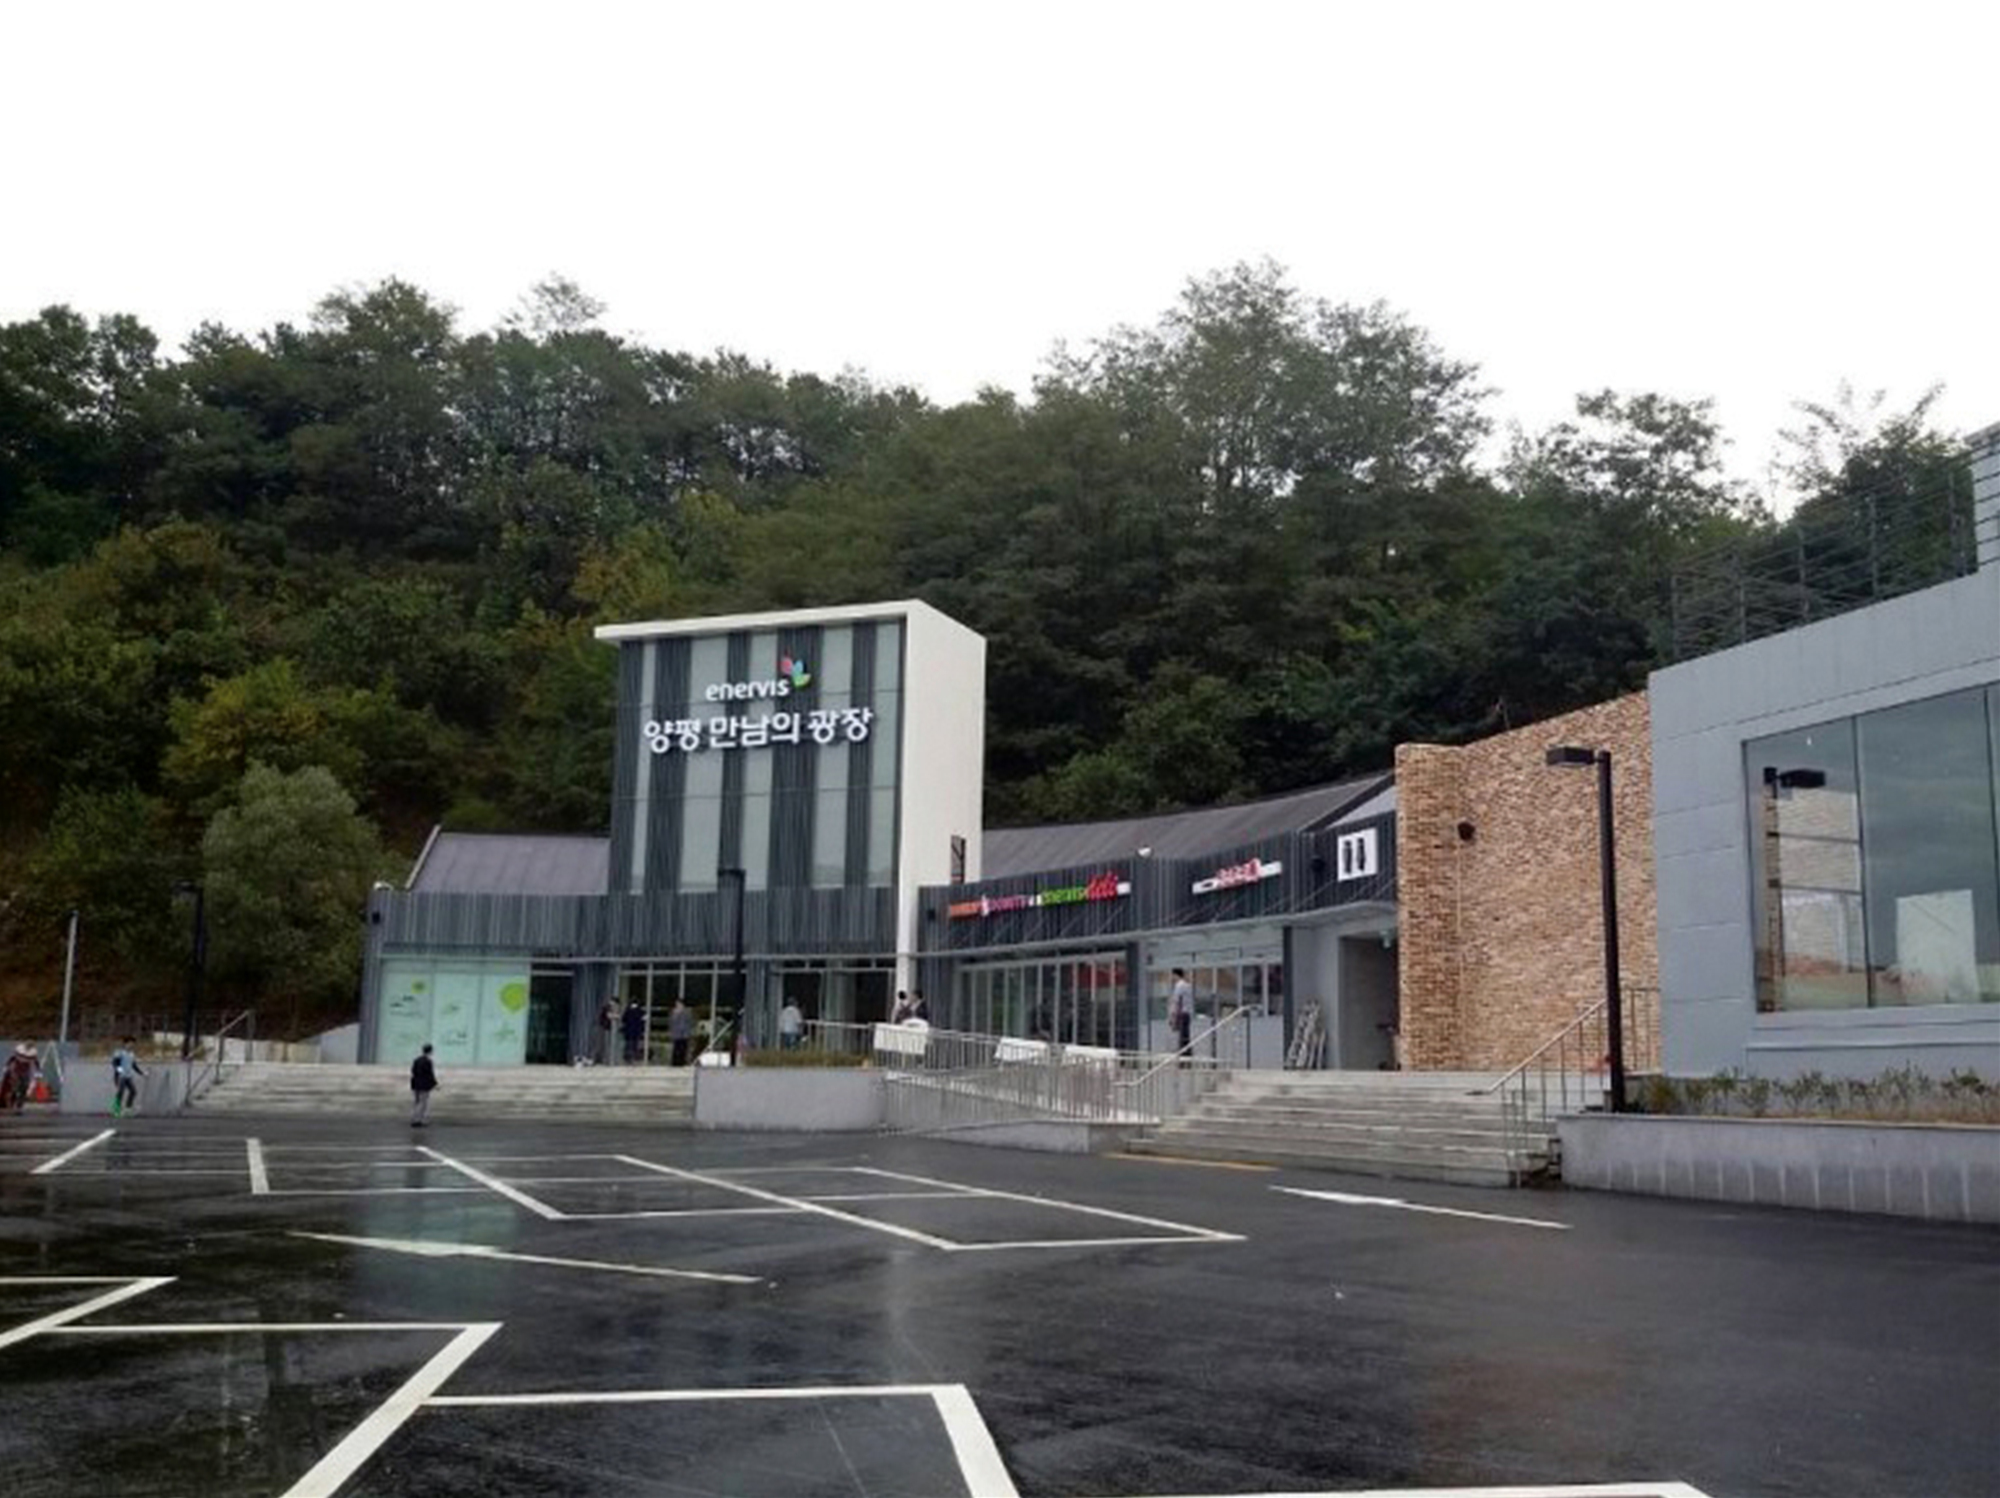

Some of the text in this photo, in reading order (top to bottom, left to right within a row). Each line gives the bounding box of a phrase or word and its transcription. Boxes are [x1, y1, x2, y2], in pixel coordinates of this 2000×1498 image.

[705, 679, 790, 702] enervis
[643, 706, 874, 754] 양평 만남의 광장
